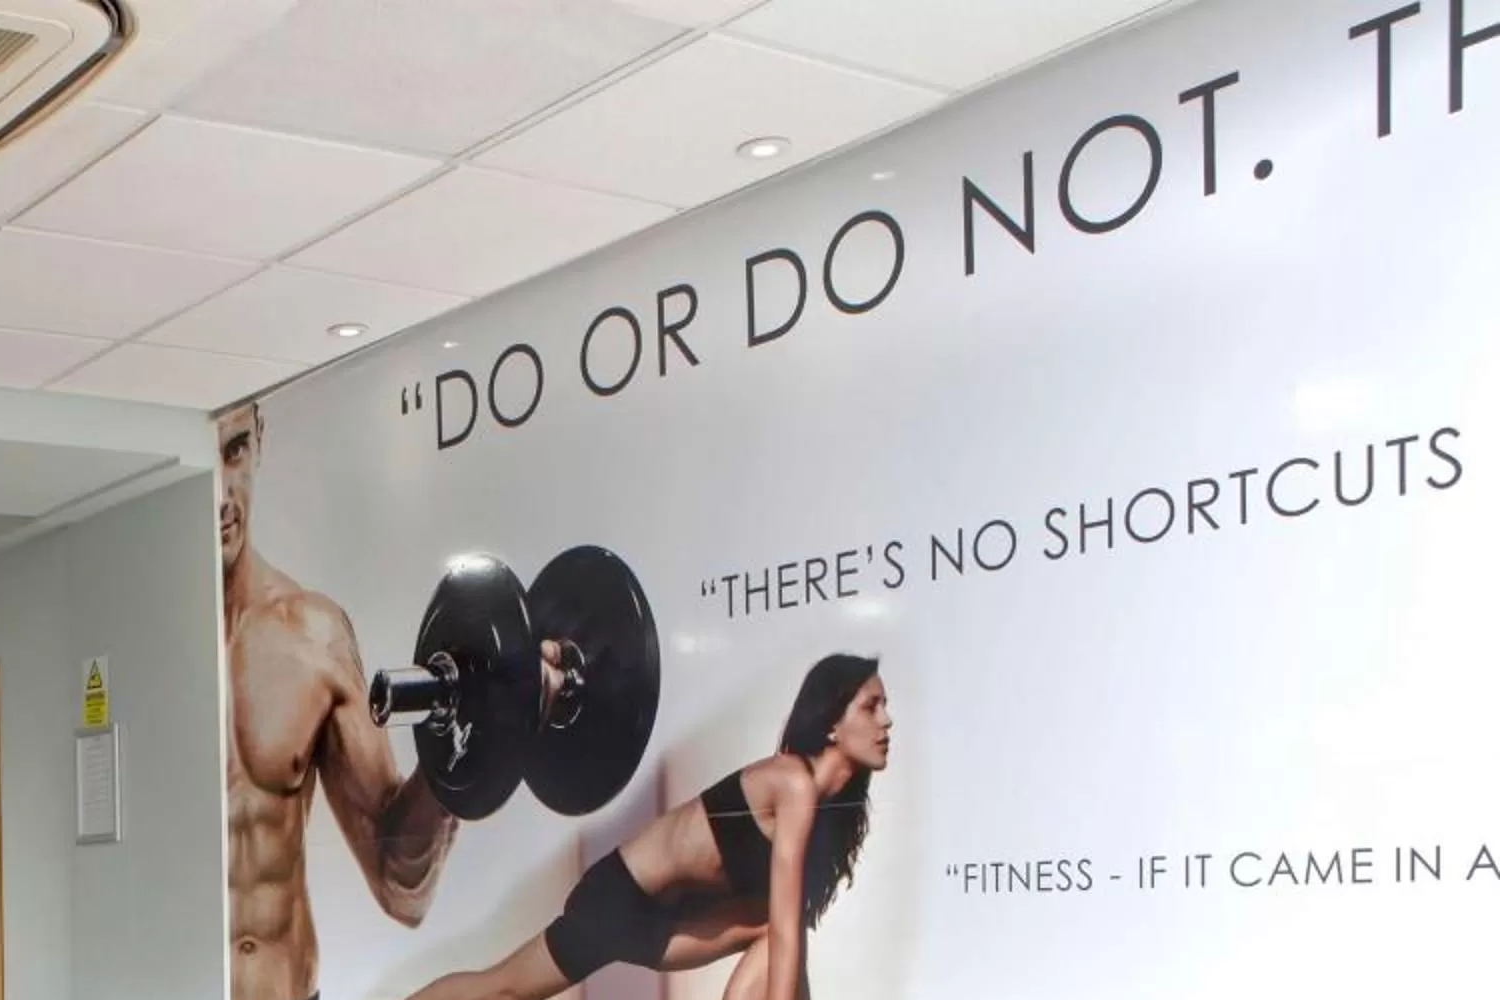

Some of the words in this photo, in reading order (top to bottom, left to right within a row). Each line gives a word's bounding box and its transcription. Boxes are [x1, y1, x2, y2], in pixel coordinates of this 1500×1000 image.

[579, 283, 701, 397] OR
[745, 209, 906, 349] DO
[962, 70, 1275, 277] NOT.
[930, 519, 1018, 581] NO
[1043, 426, 1464, 561] SHORTCUTS
[1138, 855, 1168, 890] IF
[1184, 853, 1214, 889] IT
[1229, 847, 1375, 888] CAME
[1395, 843, 1442, 884] IN
[1465, 842, 1500, 882] A
